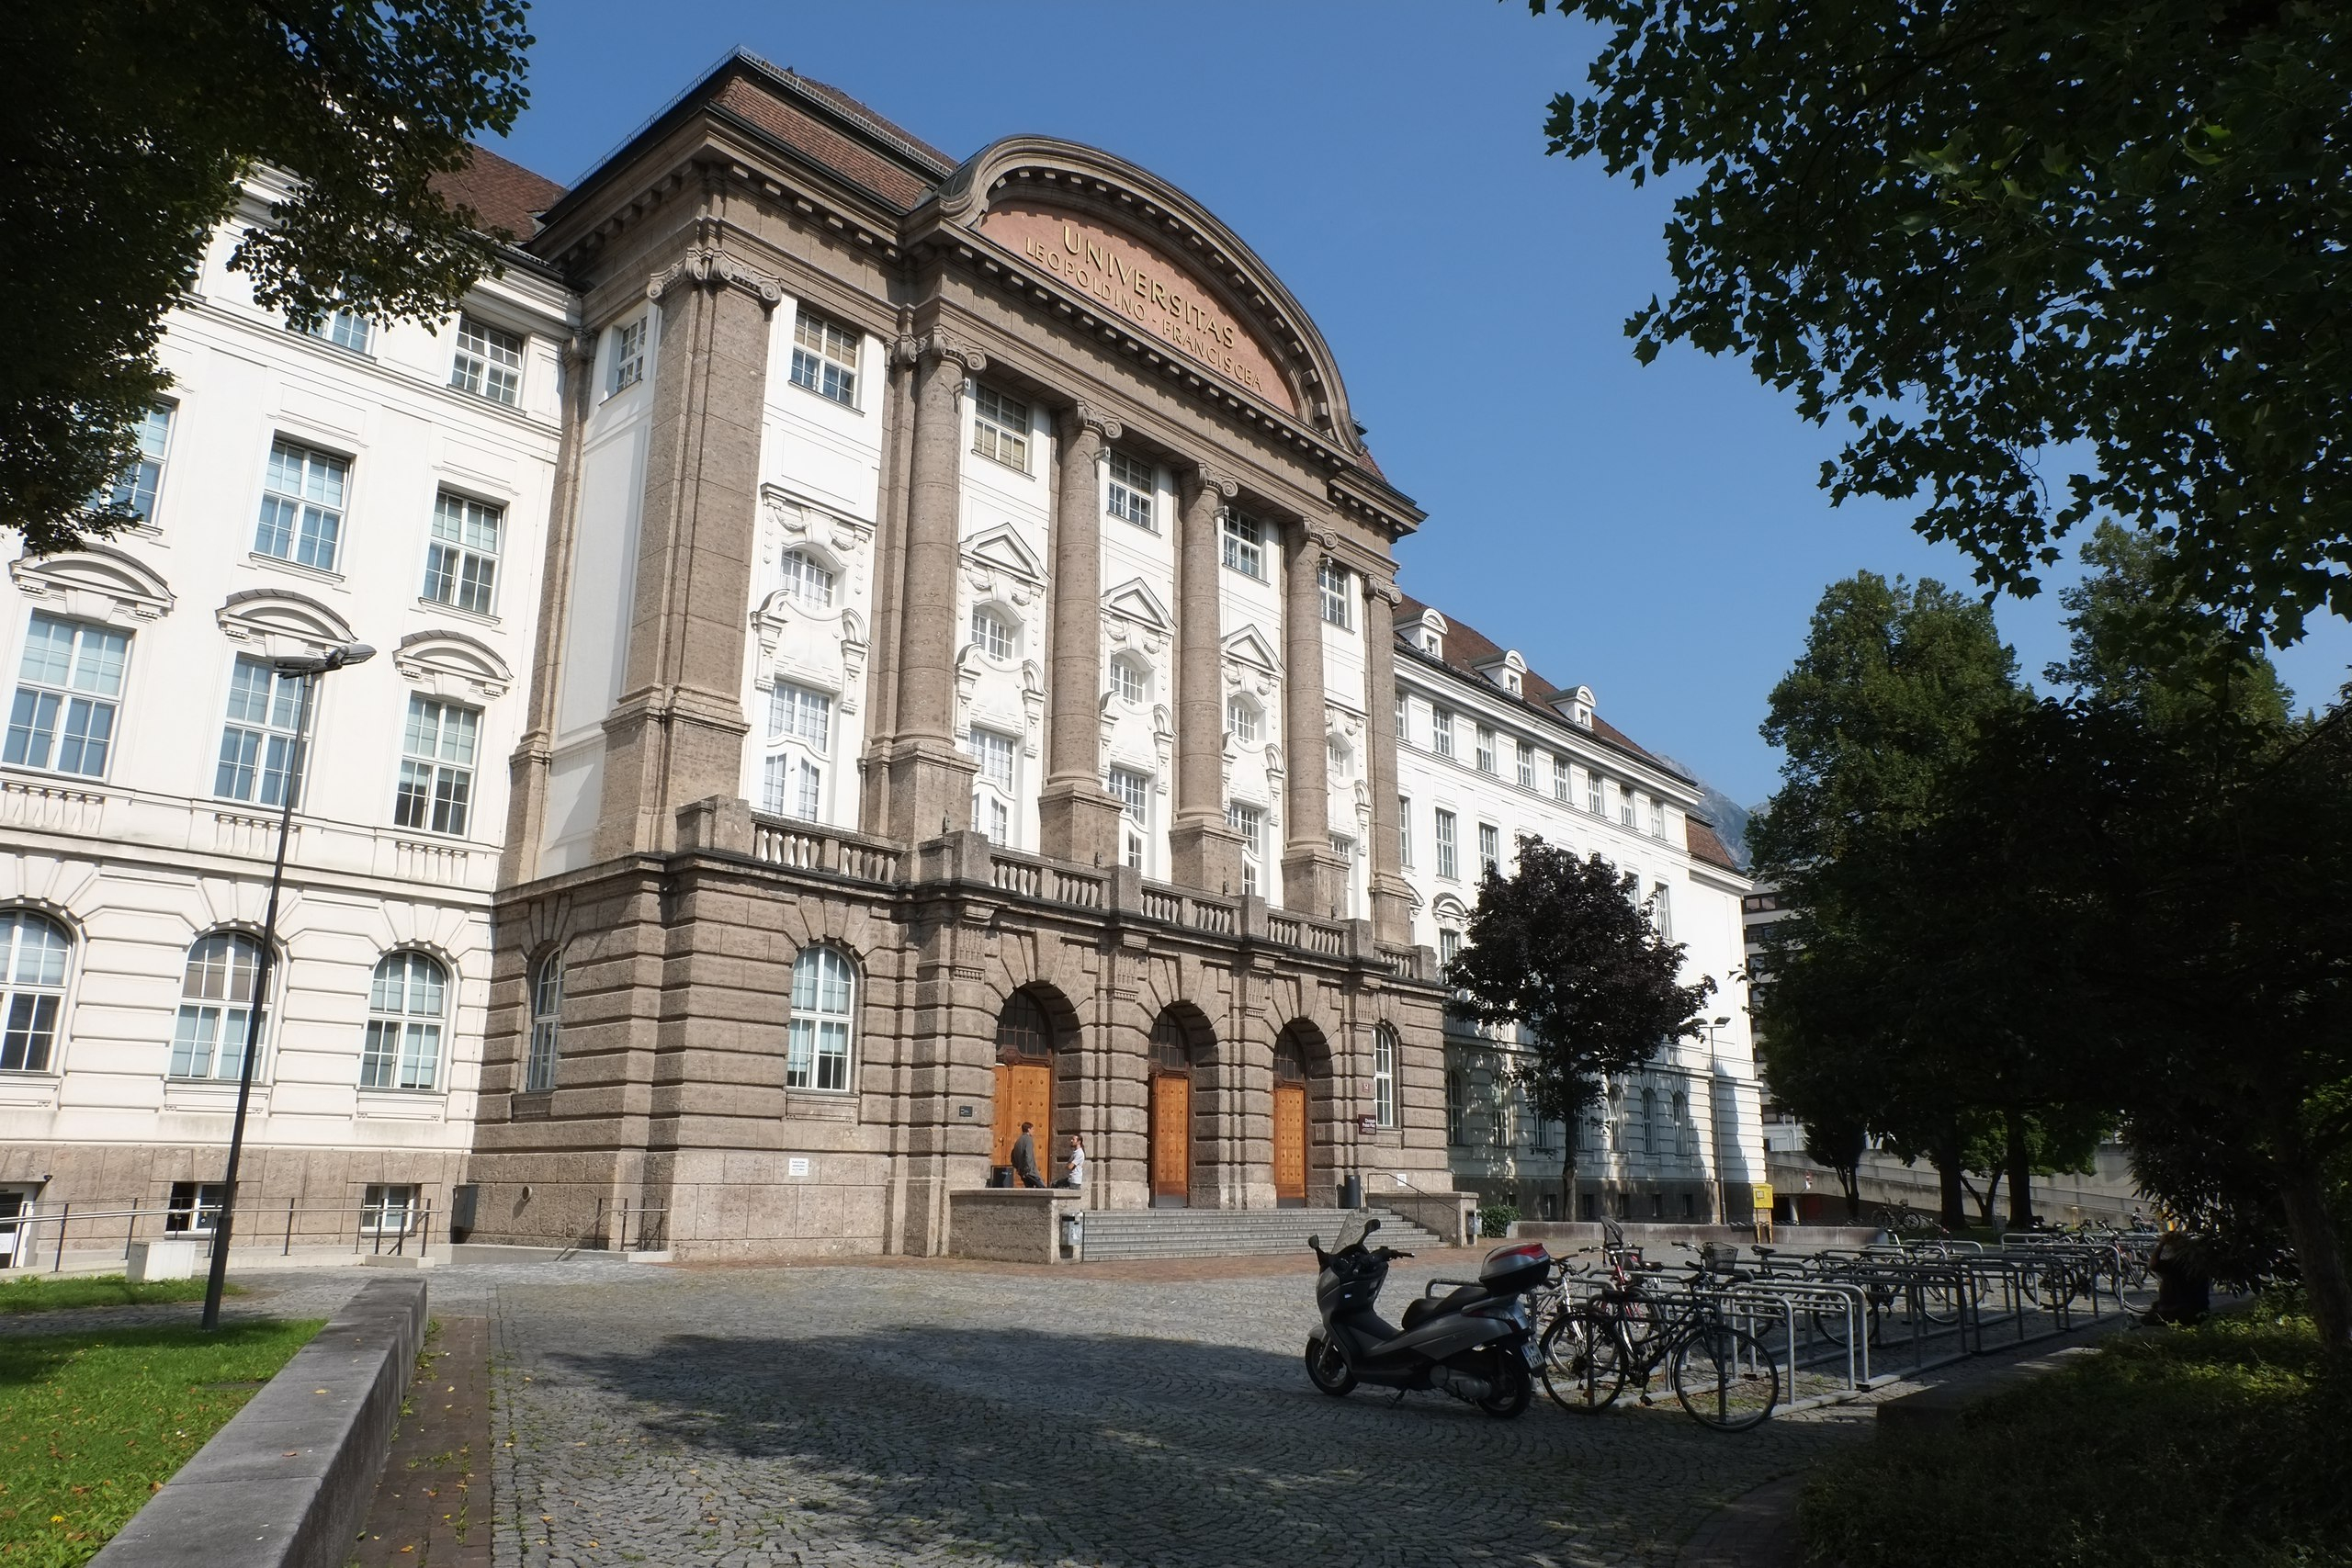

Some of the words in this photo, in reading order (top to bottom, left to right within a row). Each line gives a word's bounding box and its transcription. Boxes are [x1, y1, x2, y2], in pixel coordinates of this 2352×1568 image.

[1024, 236, 1146, 321] LEOPOLDINO
[1162, 318, 1262, 392] FRANCISCEA
[1063, 225, 1235, 349] UNIVERSITAS
